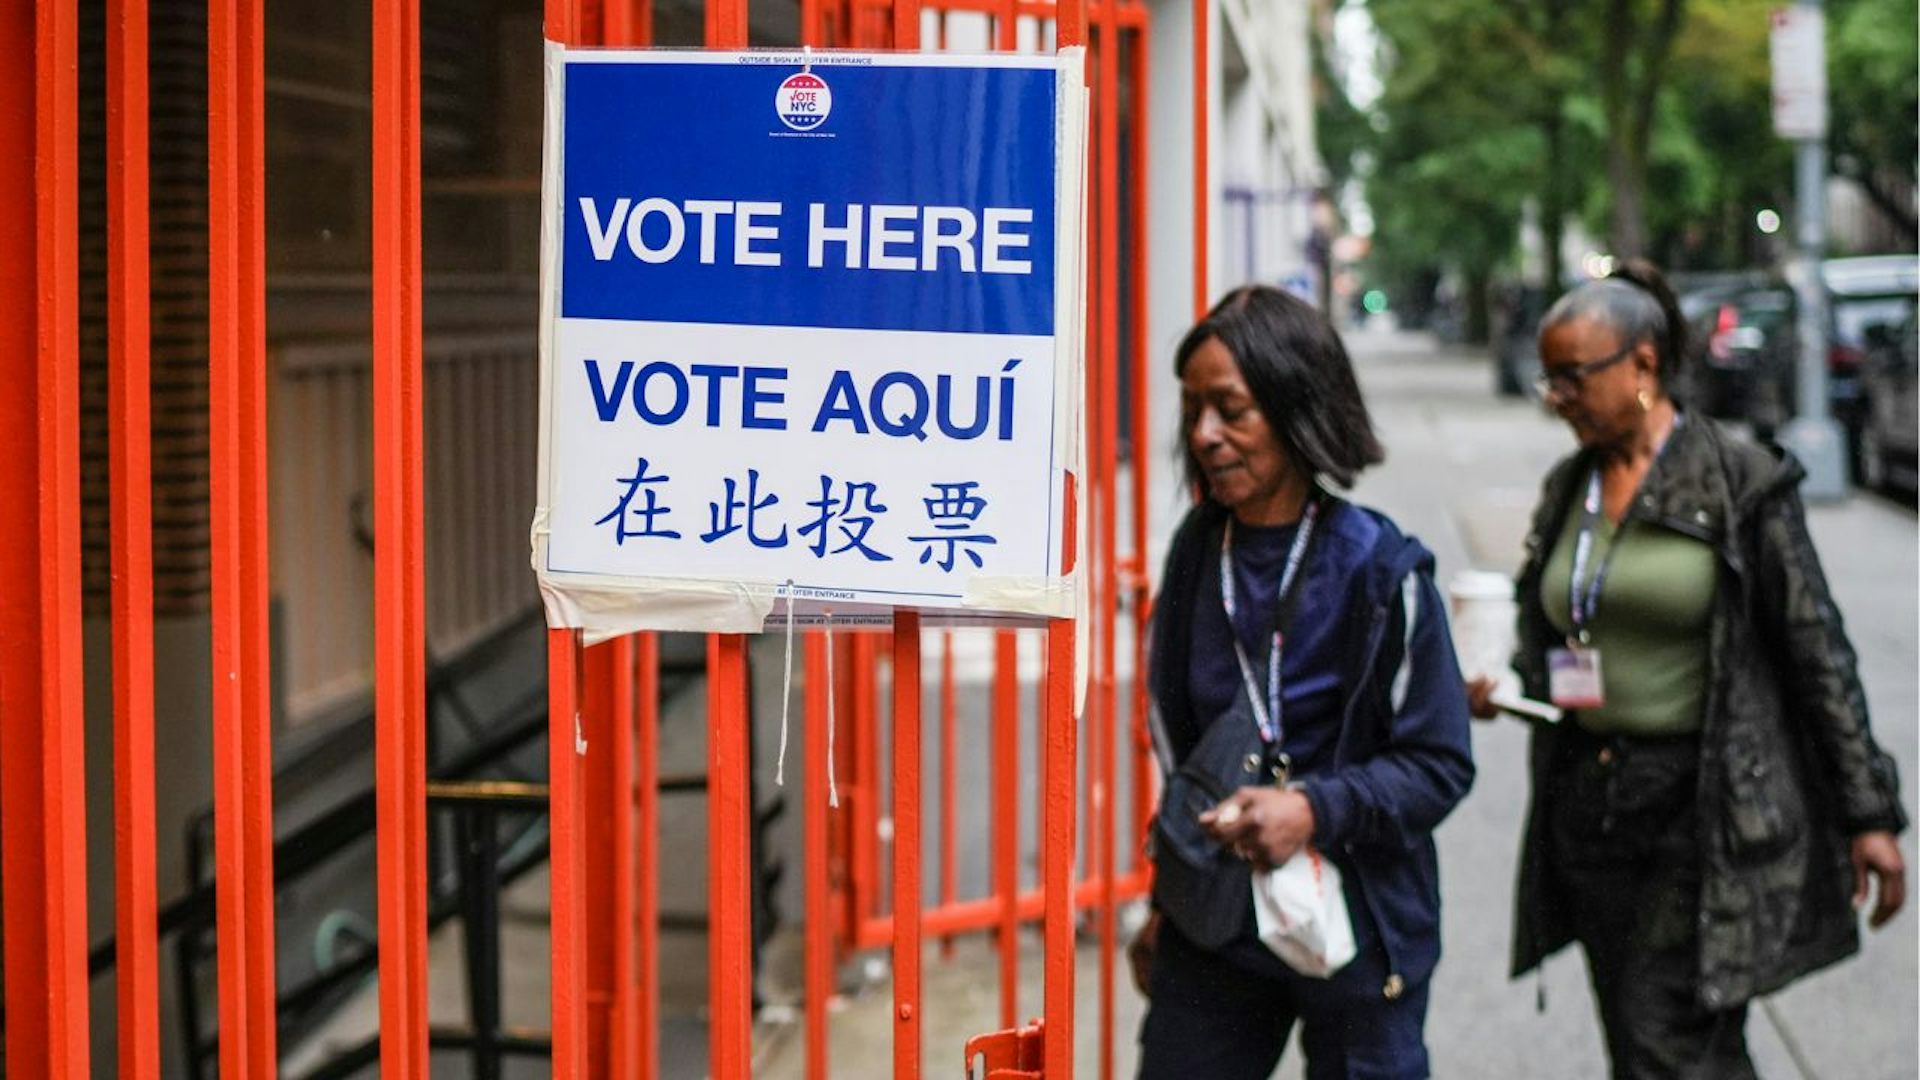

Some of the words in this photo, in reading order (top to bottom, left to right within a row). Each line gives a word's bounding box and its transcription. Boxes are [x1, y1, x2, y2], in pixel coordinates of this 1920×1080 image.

[773, 56, 791, 64] SIGN
[793, 56, 802, 64] AT
[830, 57, 872, 65] ENTRANCE
[790, 90, 816, 101] VOTE
[790, 102, 816, 112] NYC
[579, 197, 782, 266] VOTE
[808, 203, 1033, 274] HERE
[584, 360, 788, 430] VOTE
[812, 359, 1023, 442] AQUÍ
[595, 457, 997, 573] 在此投票
[789, 588, 813, 597] OTER
[814, 590, 856, 599] ENTRANCE
